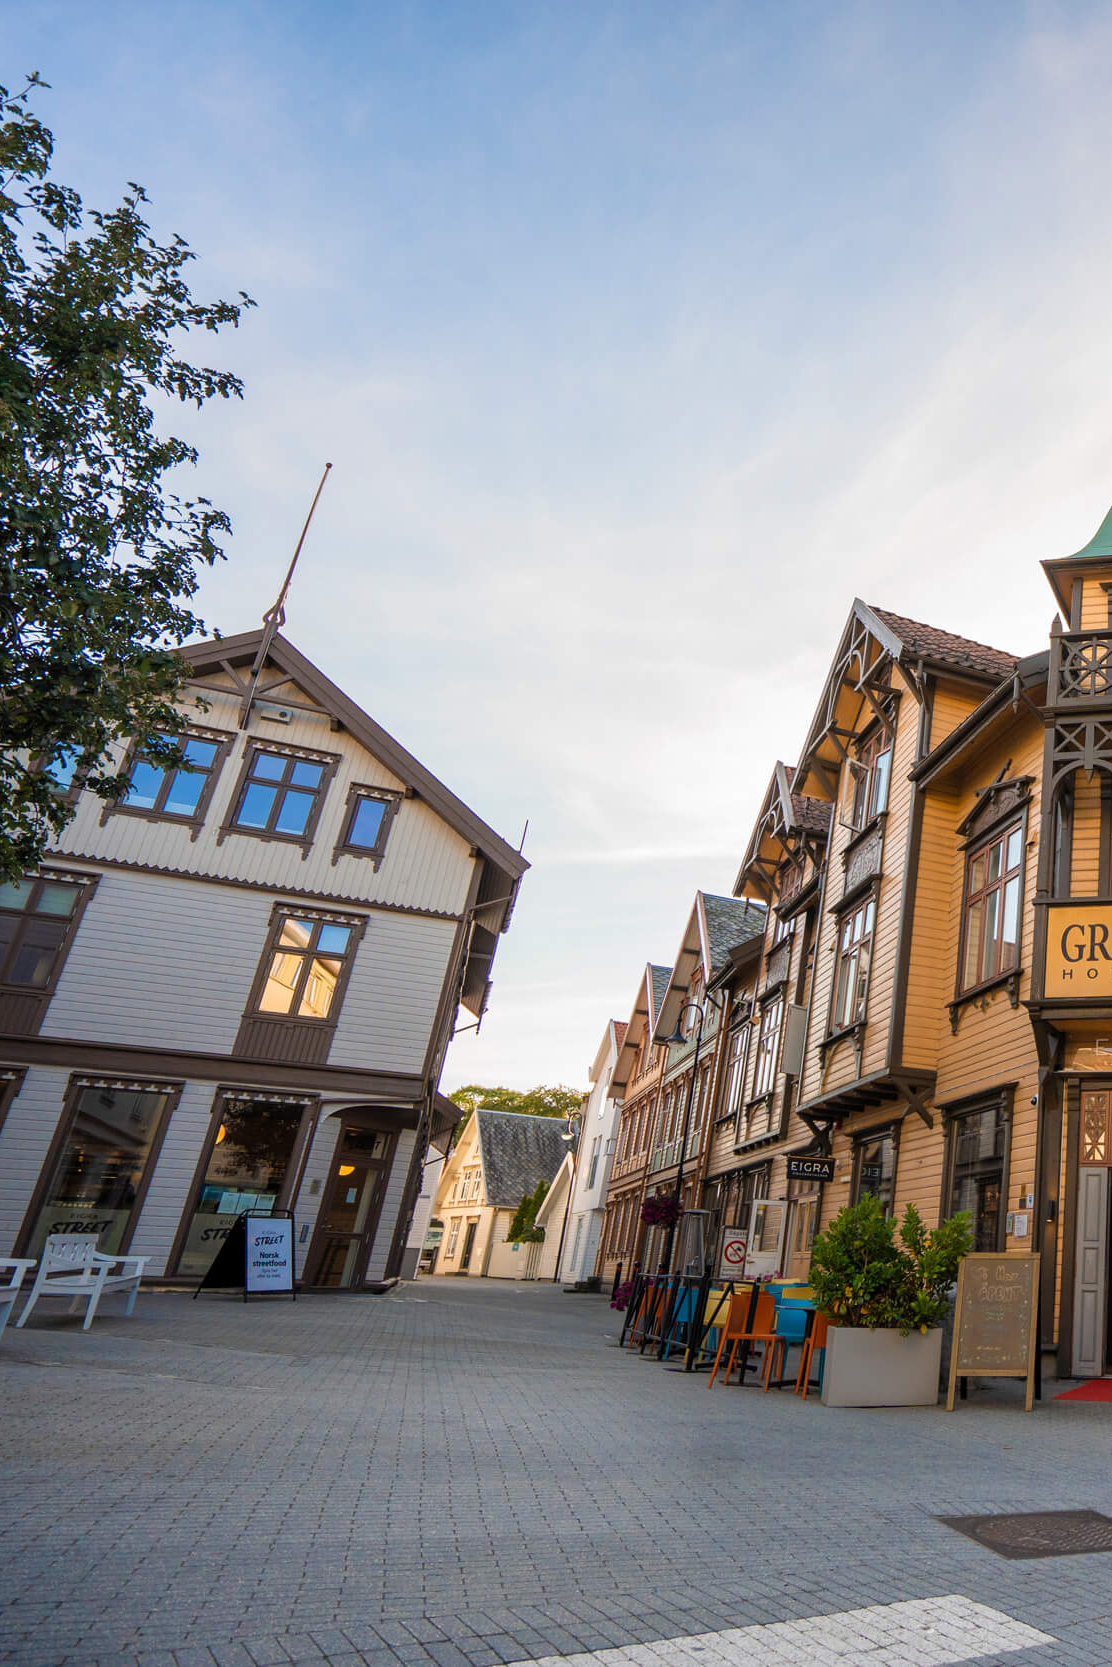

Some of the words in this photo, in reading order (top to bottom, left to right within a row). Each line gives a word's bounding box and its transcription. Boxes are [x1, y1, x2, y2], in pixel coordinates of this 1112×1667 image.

[790, 1161, 830, 1173] EIGRA
[49, 1221, 113, 1234] STREET
[254, 1235, 284, 1247] STREET
[253, 1259, 287, 1267] streetfood
